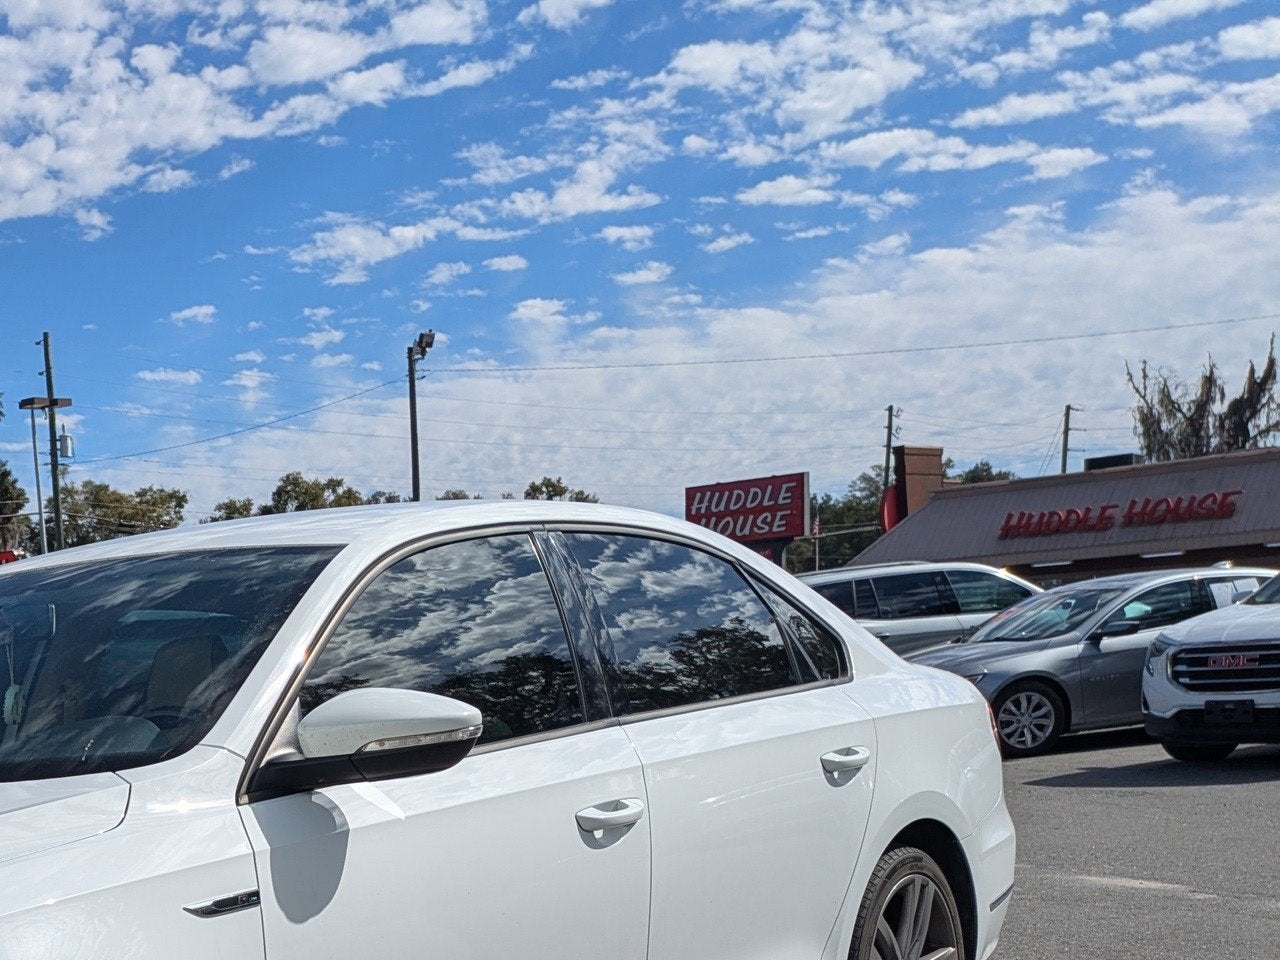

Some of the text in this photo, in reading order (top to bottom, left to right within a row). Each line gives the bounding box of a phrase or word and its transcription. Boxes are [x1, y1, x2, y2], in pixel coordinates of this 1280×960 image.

[691, 482, 797, 515] HUDDLE
[999, 490, 1243, 540] HUDDLE HOUSE
[1208, 655, 1259, 670] GMC
